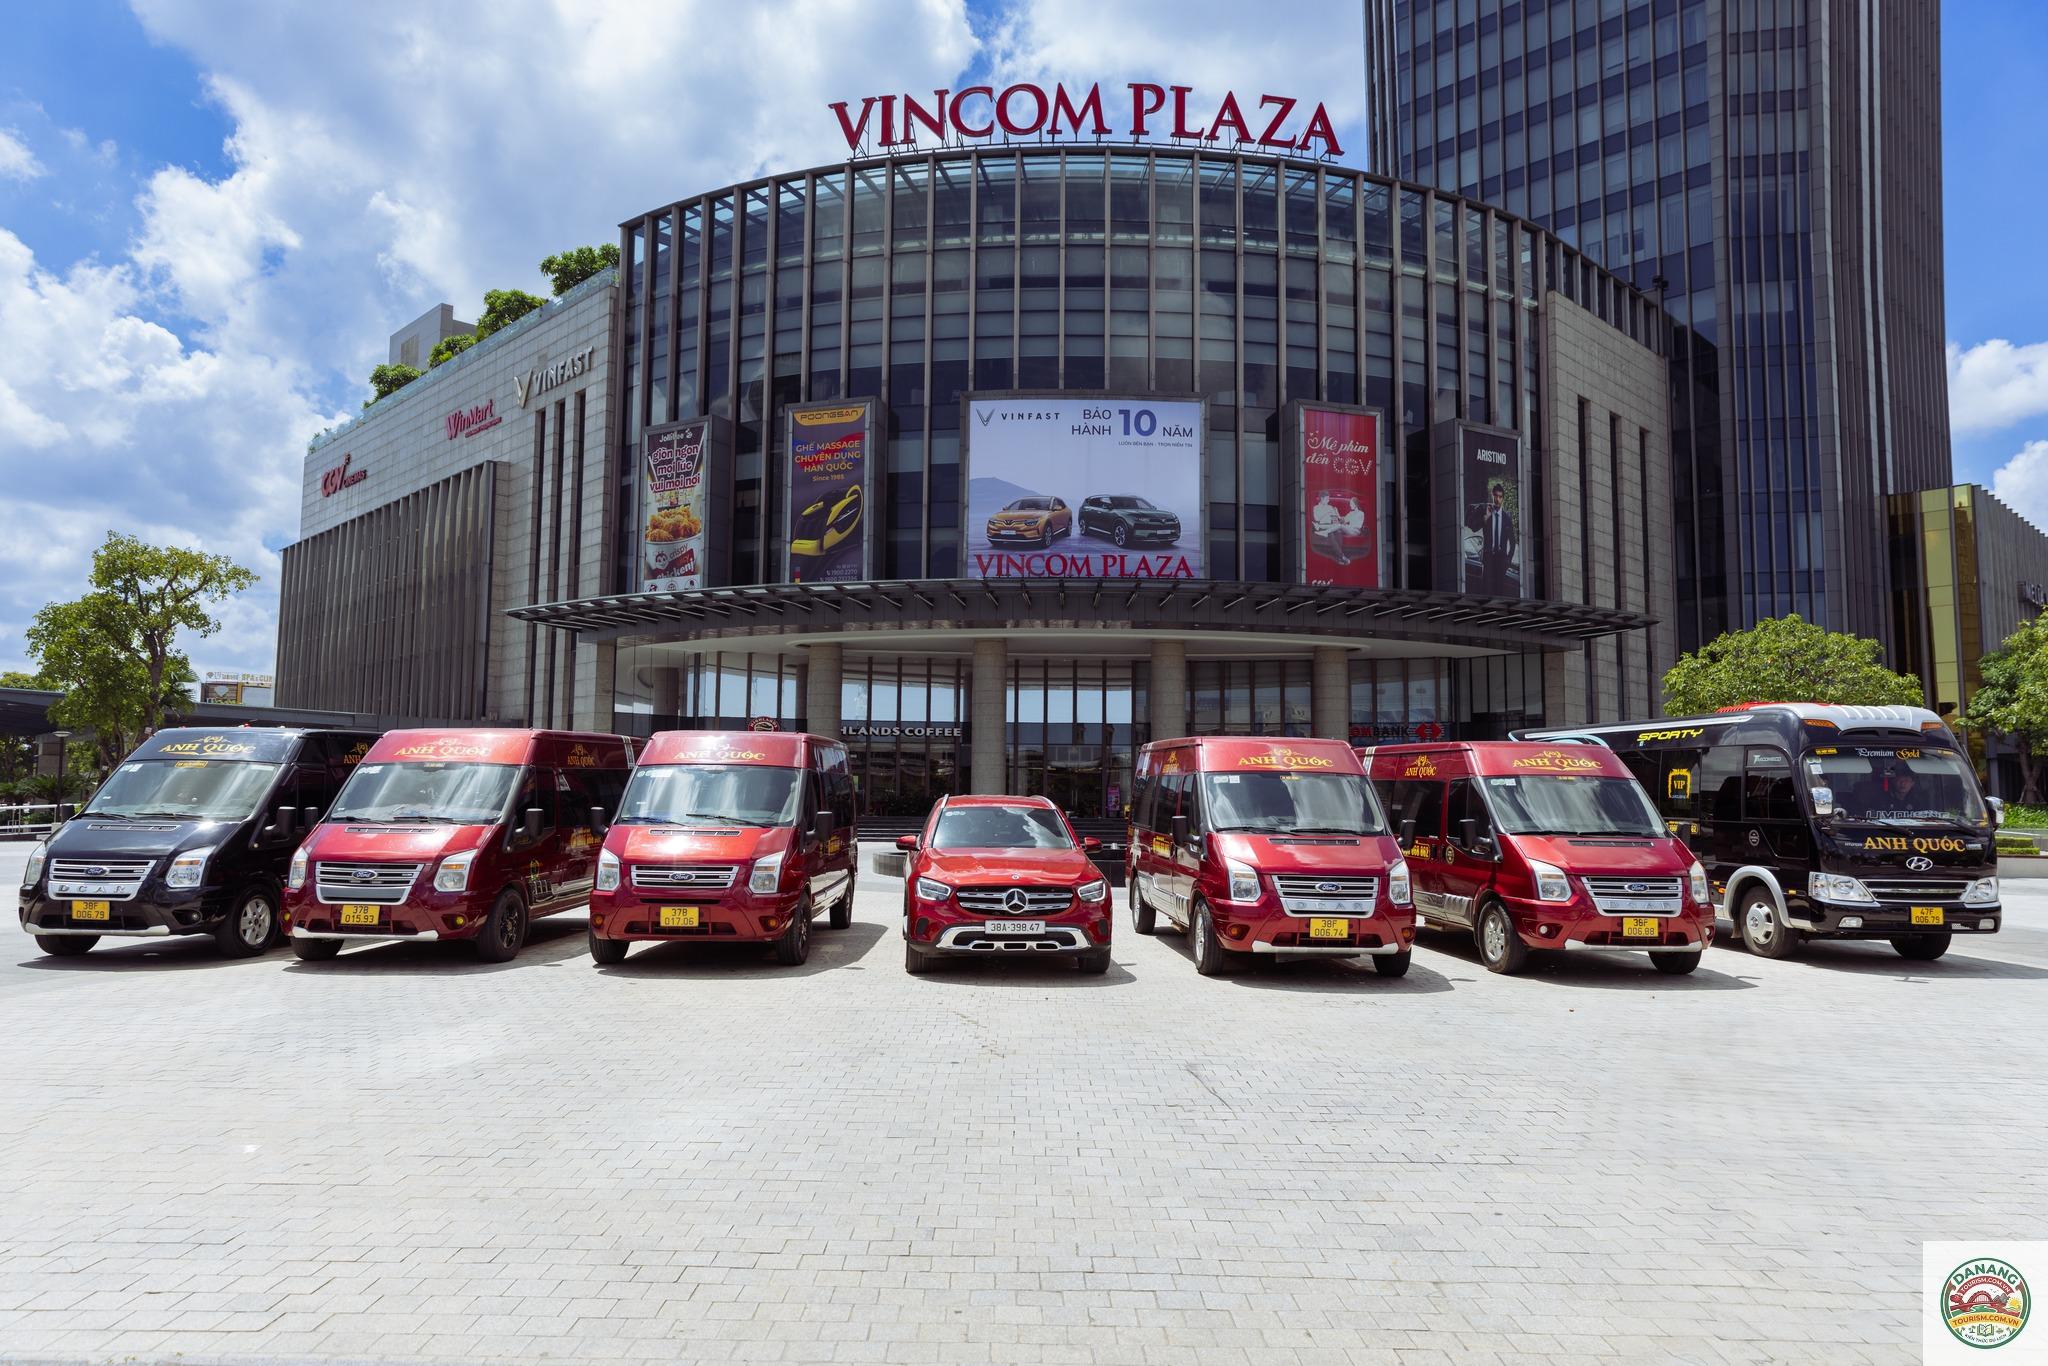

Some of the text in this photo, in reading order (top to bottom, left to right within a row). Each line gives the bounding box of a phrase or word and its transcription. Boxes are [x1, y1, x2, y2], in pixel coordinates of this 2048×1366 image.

[828, 82, 1345, 156] VINCOM PLAZA
[532, 346, 594, 395] VINFAST
[800, 410, 859, 421] POONGSAN
[1001, 412, 1061, 421] VINFAST
[1082, 406, 1112, 421] BẢO
[446, 398, 495, 441] WinMart
[1118, 408, 1158, 437] 10
[1071, 422, 1112, 436] HÀNH
[1162, 424, 1193, 438] NĂM
[816, 440, 861, 451] MASSAGE
[1332, 440, 1369, 455] phim
[675, 444, 699, 459] ngon
[1477, 448, 1507, 465] ARISTINO
[794, 452, 832, 463] CHUYÊN
[657, 459, 693, 478] mọi lúc
[804, 463, 824, 473] HÀN
[1306, 452, 1372, 475] đến CGV
[649, 478, 665, 492] vui
[665, 475, 685, 491] mọi
[974, 553, 1195, 579] VINCOM PLAZA
[904, 727, 962, 738] COFFEE
[1637, 728, 1704, 742] SPORTY
[158, 743, 202, 752] ANH
[393, 746, 436, 756] ANH
[1855, 747, 1920, 760] Premium Gold
[343, 754, 361, 765] ANH
[1238, 756, 1277, 766] ANH
[1513, 758, 1552, 768] ANH
[1404, 767, 1418, 777] ANH
[1673, 780, 1686, 790] VIP
[1863, 835, 1966, 853] ANH QUỐC
[87, 867, 103, 875] Ford
[356, 870, 372, 879] Ford
[1321, 883, 1337, 891] Ford
[1630, 883, 1645, 891] Ford
[82, 901, 98, 911] 38F
[76, 910, 105, 920] 006.79
[671, 908, 688, 917] 37B
[344, 914, 375, 924] 015.93
[664, 917, 695, 926] 017.06
[1321, 919, 1338, 928] 38F
[1915, 916, 1940, 924] 006.79
[990, 922, 1040, 932] 38A-398.47
[1627, 927, 1655, 936] 006.88
[1314, 928, 1344, 937] 006.74
